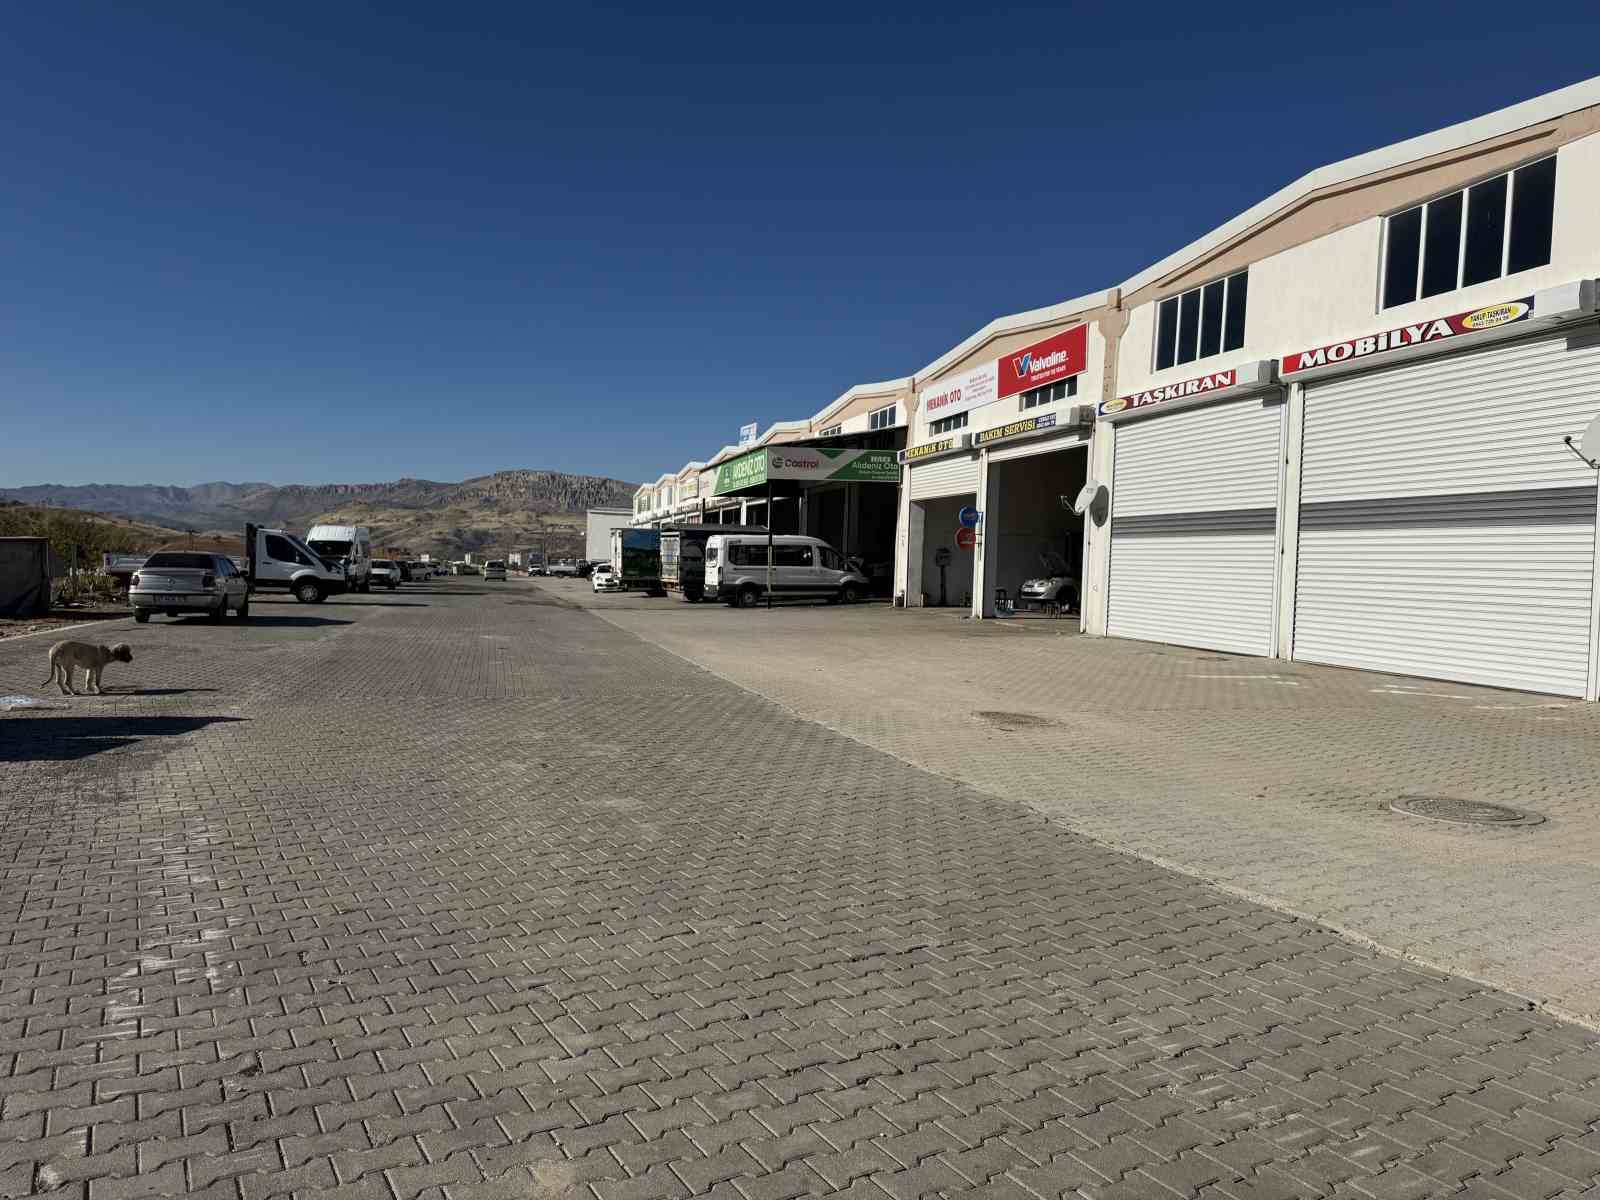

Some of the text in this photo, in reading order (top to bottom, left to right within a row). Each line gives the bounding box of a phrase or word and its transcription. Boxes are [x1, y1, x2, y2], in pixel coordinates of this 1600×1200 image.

[1298, 319, 1455, 369] MOBİLYA
[1029, 350, 1067, 374] Valvoline
[950, 388, 962, 403] OTO
